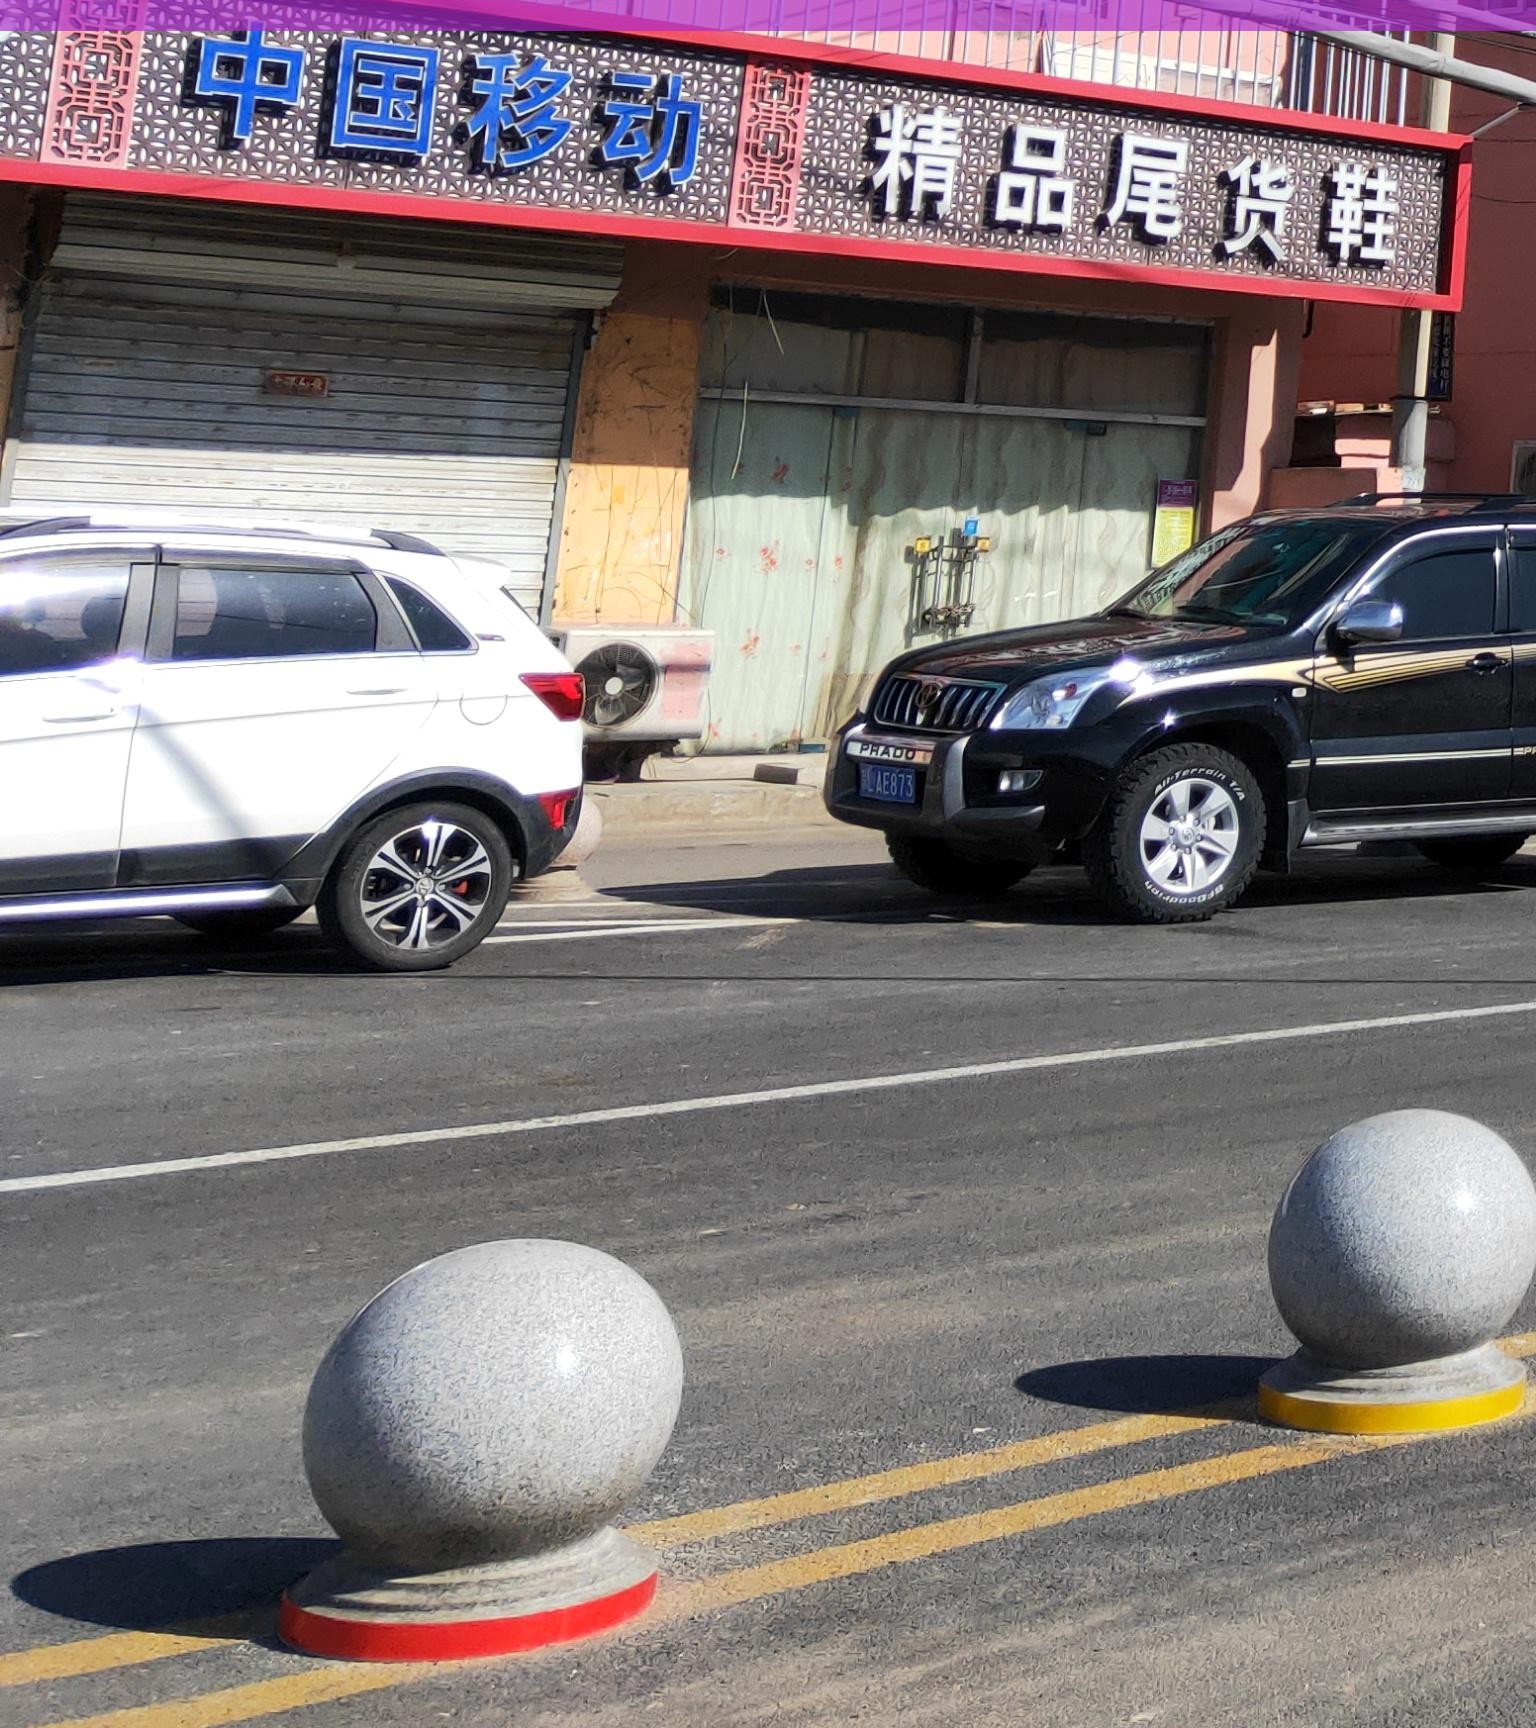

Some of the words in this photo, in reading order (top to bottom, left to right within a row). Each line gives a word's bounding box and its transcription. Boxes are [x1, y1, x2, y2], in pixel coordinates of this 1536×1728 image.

[195, 20, 703, 184] 中国移动
[870, 103, 1400, 264] 精品尾货鞋
[859, 743, 917, 761] PRADO
